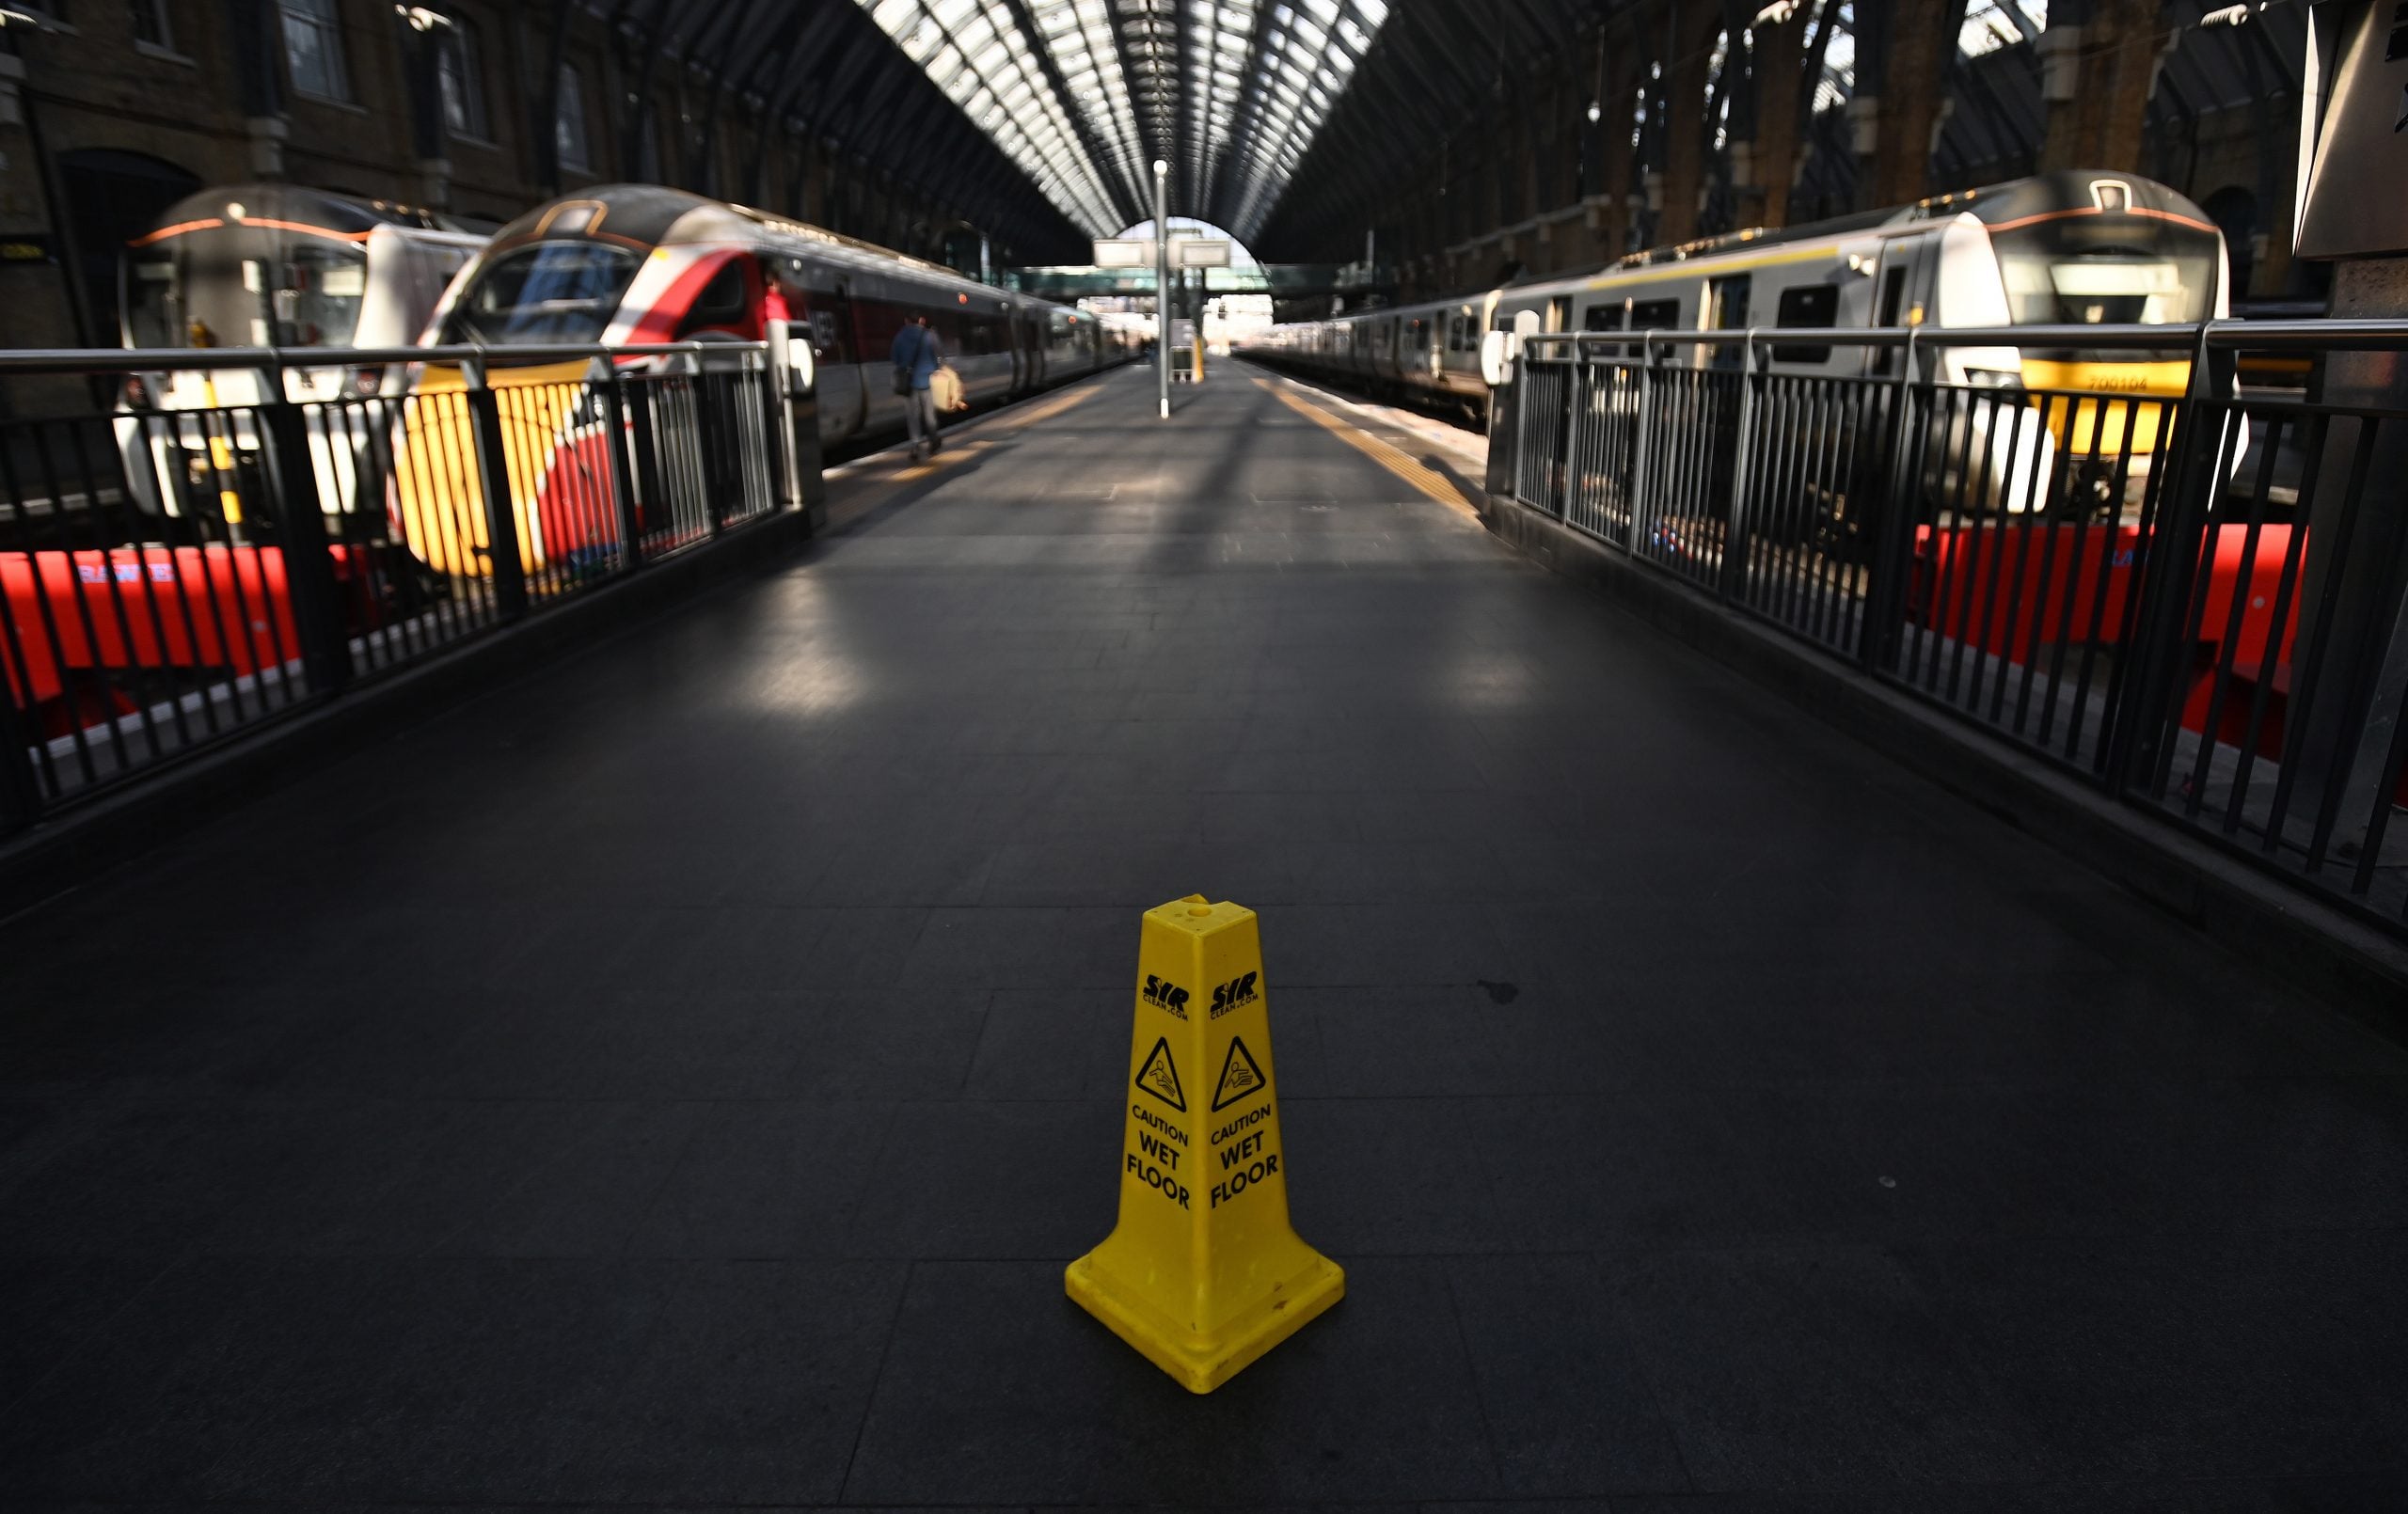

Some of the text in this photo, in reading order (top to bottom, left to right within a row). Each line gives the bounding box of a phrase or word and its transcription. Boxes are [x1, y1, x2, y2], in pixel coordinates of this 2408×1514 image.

[2090, 377, 2147, 392] 700104
[1143, 974, 1190, 1013] SIR
[1143, 994, 1189, 1022] CLEAN.COM
[1210, 970, 1258, 1013] SIR
[1210, 993, 1259, 1020] CLEAN.COM
[1132, 1105, 1188, 1147] CAUTION
[1211, 1103, 1271, 1145] CAUTION
[1139, 1130, 1180, 1171] WET
[1220, 1129, 1263, 1170] WET
[1127, 1153, 1190, 1210] FLOOR
[1211, 1155, 1277, 1209] FLOOR
